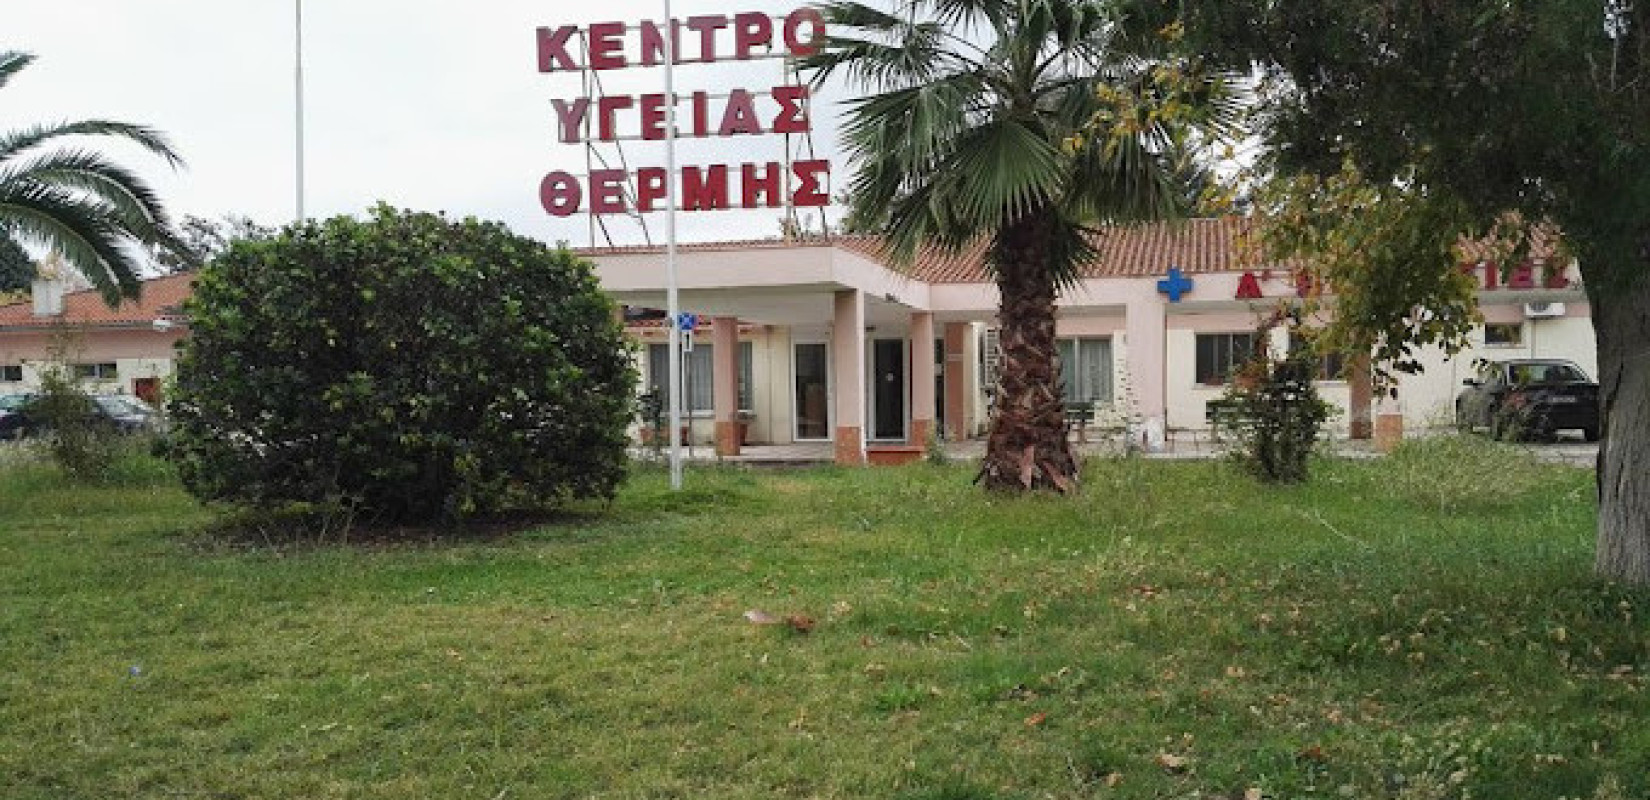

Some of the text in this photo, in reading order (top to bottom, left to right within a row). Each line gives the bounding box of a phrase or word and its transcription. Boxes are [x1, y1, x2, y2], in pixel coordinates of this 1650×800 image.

[536, 8, 825, 72] ΚΕΝΤΡΟ
[550, 85, 811, 143] ΥΓΕΙΑΣ
[540, 160, 830, 217] ΘΕΡΜΗΣ
